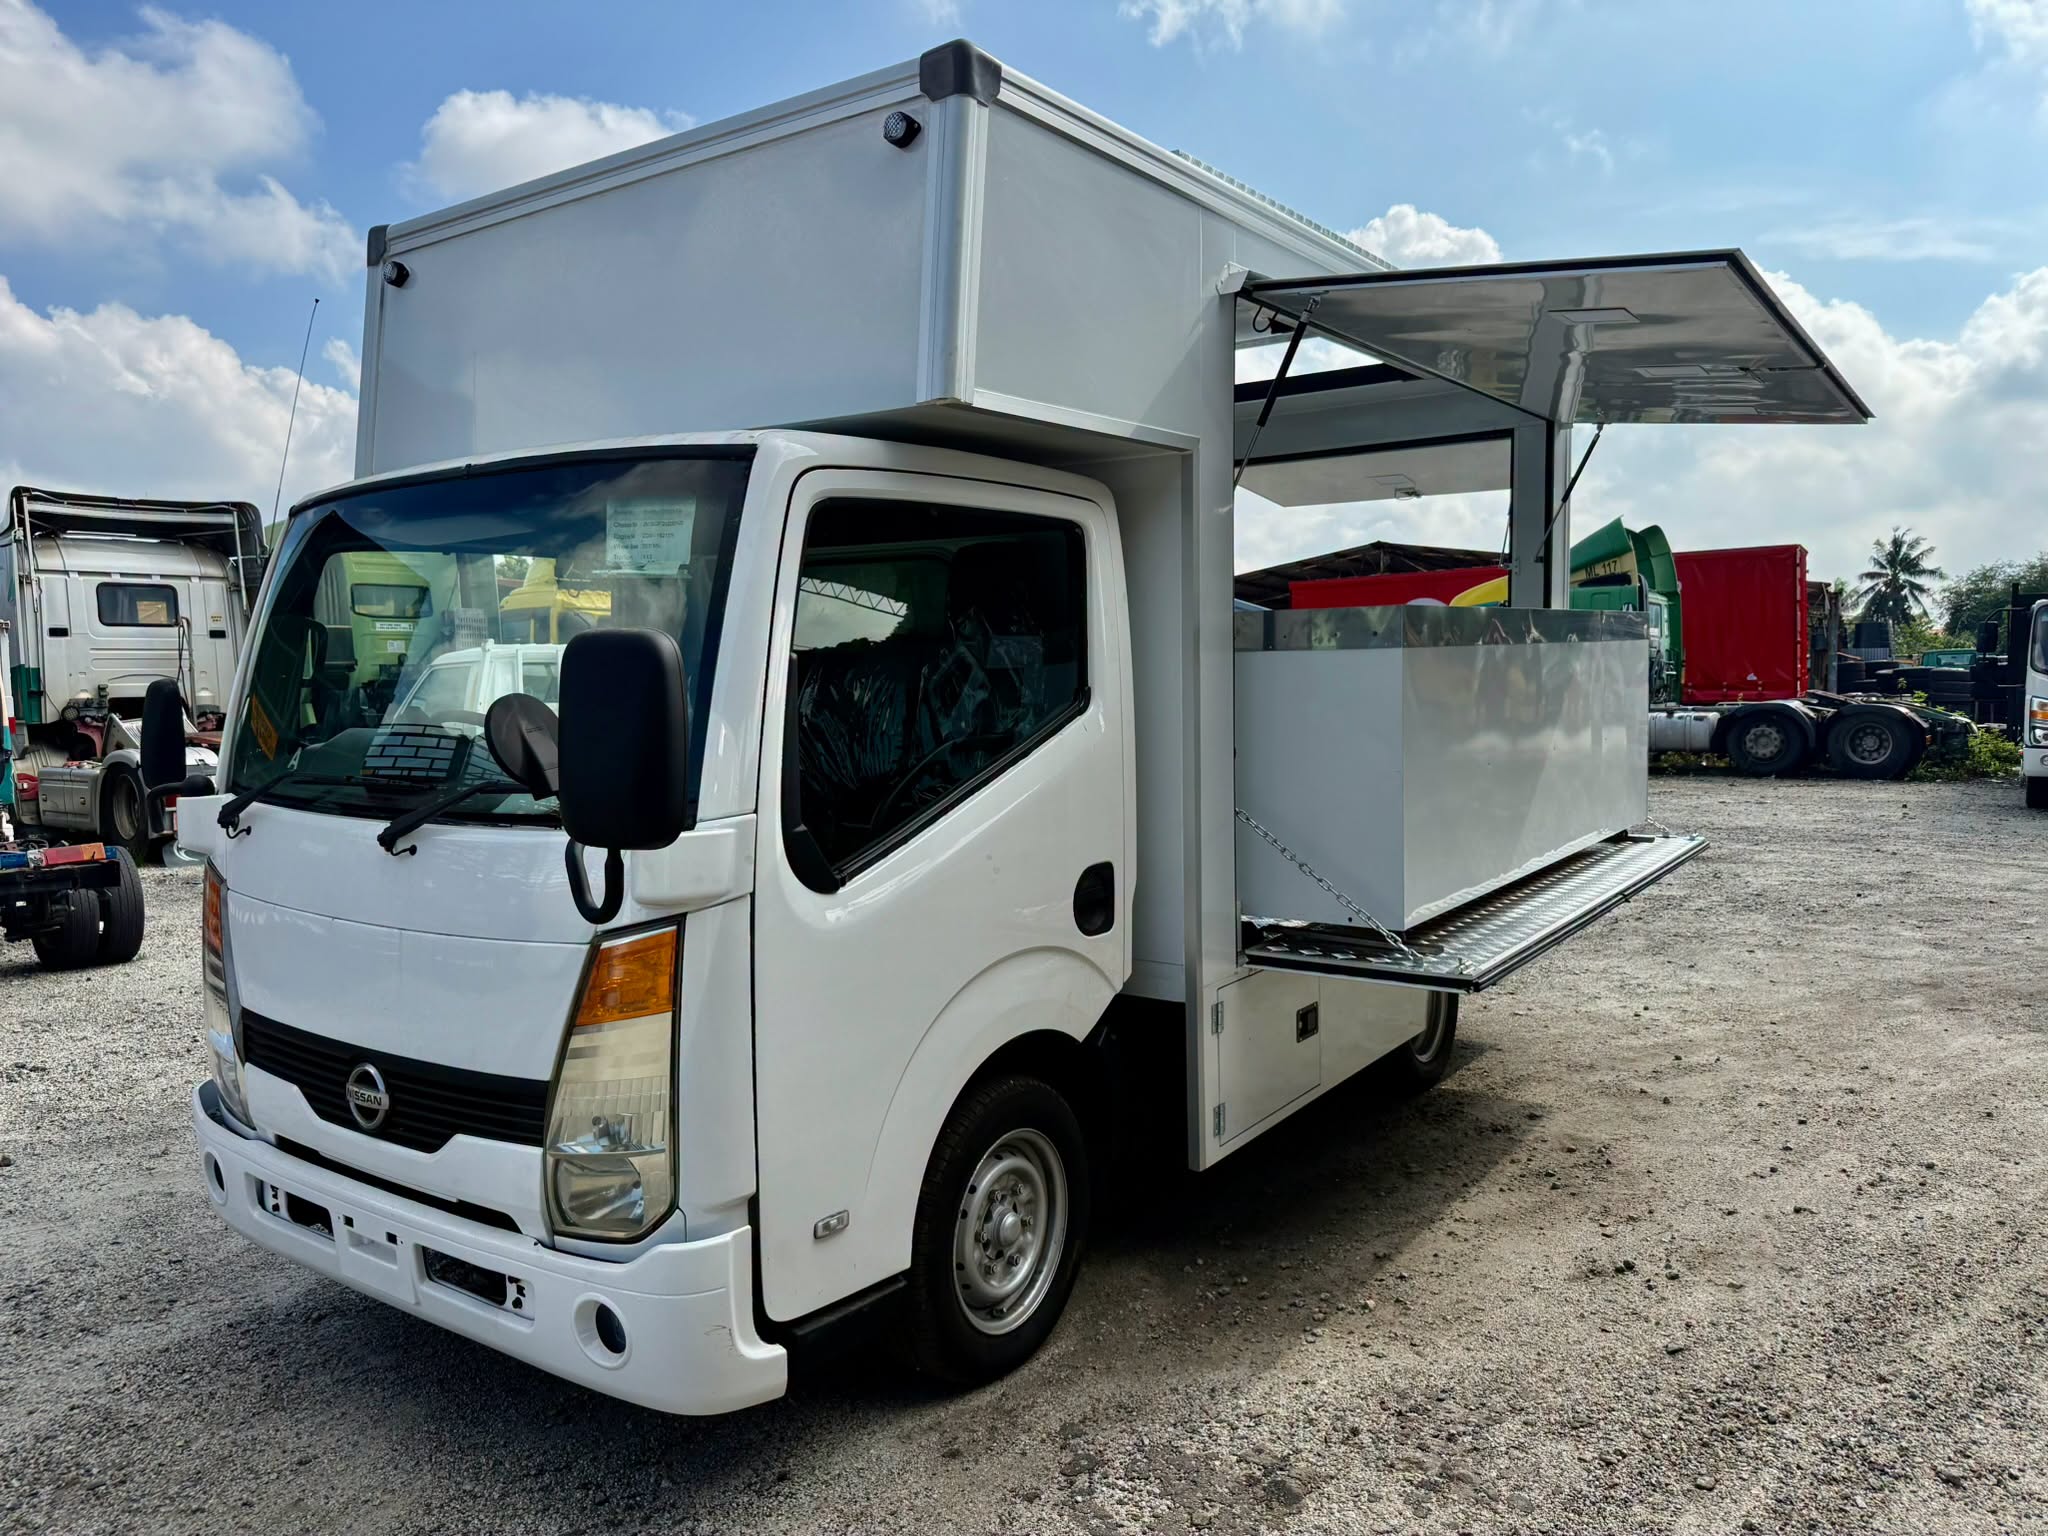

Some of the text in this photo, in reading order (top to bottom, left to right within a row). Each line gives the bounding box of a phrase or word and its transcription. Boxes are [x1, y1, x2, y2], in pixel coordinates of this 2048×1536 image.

[1585, 560, 1617, 579] ML 117
[347, 1086, 382, 1106] NISSAN
